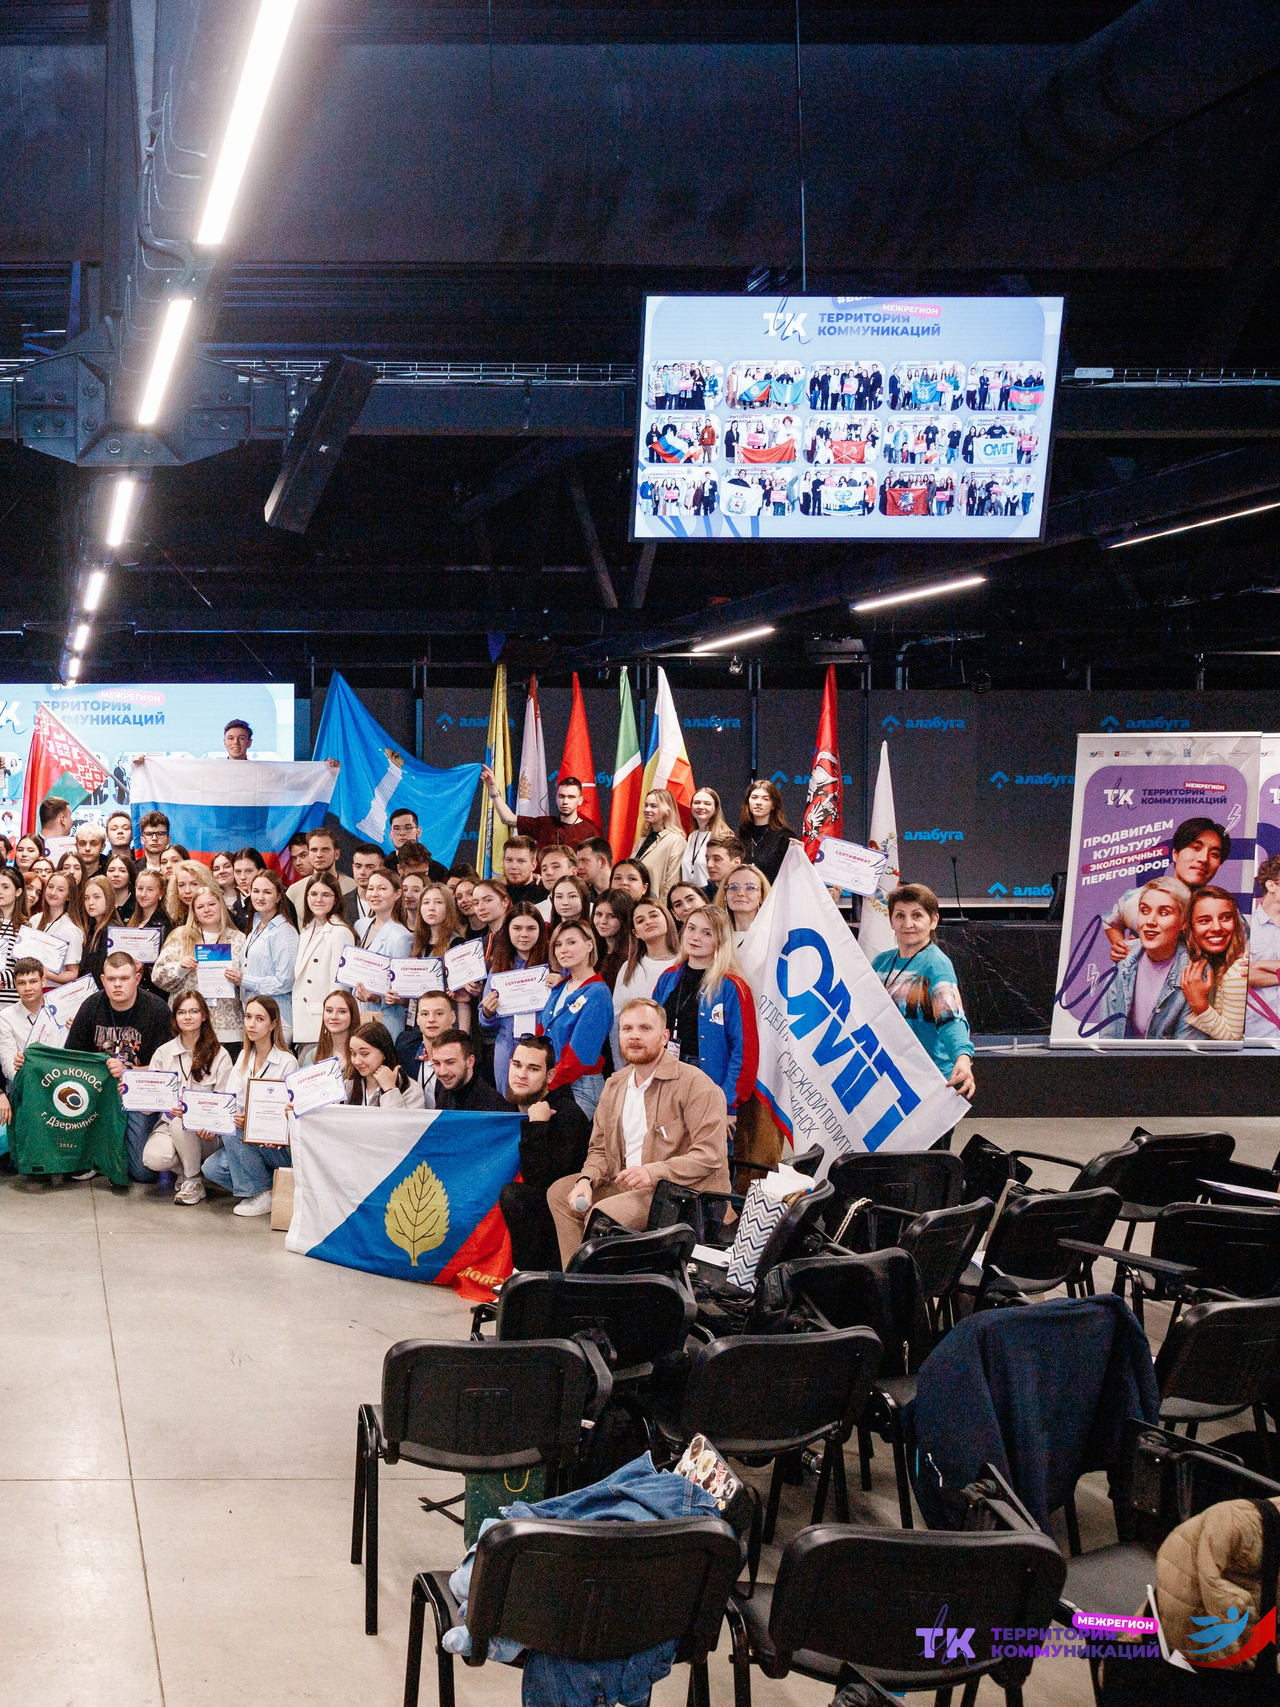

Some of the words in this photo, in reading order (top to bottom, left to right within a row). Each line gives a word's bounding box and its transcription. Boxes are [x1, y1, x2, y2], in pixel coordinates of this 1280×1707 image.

[882, 303, 939, 316] МЕЖРЕГИОН
[819, 312, 910, 323] ТЕРРИТОРИЯ
[817, 323, 941, 338] КОММУНИКАЦИЙ
[100, 690, 161, 703] МЕЖРЕГИОН
[905, 716, 966, 731] алабуга
[1125, 716, 1191, 731] алабуга
[1014, 772, 1075, 788] алабуга
[1185, 782, 1226, 791] МЕЖРЕГИОН
[1140, 794, 1227, 805] КОММУНИКАЦИЙ
[1142, 788, 1206, 796] ТЕРРИТОРИЯ
[903, 829, 964, 844] алабуга
[1082, 819, 1174, 849] ПРОДВИГАЕМ
[1092, 835, 1162, 860] КУЛЬТУРУ
[835, 850, 871, 864] СЕРТИФИКАТ
[1089, 847, 1164, 872] ЭКОЛОГИЧНЫХ
[1081, 858, 1170, 886] ПЕРЕГОВОРОВ
[353, 956, 384, 968] СЕРТИФИКАТ
[504, 976, 537, 987] СЕРТИФИКАТ
[776, 927, 921, 1153] ОМП
[41, 1068, 61, 1087] СПО
[62, 1067, 103, 1093] «КОКОС»
[297, 1070, 327, 1085] СЕРТИФИКАТ
[45, 1111, 99, 1132] Дзержинск
